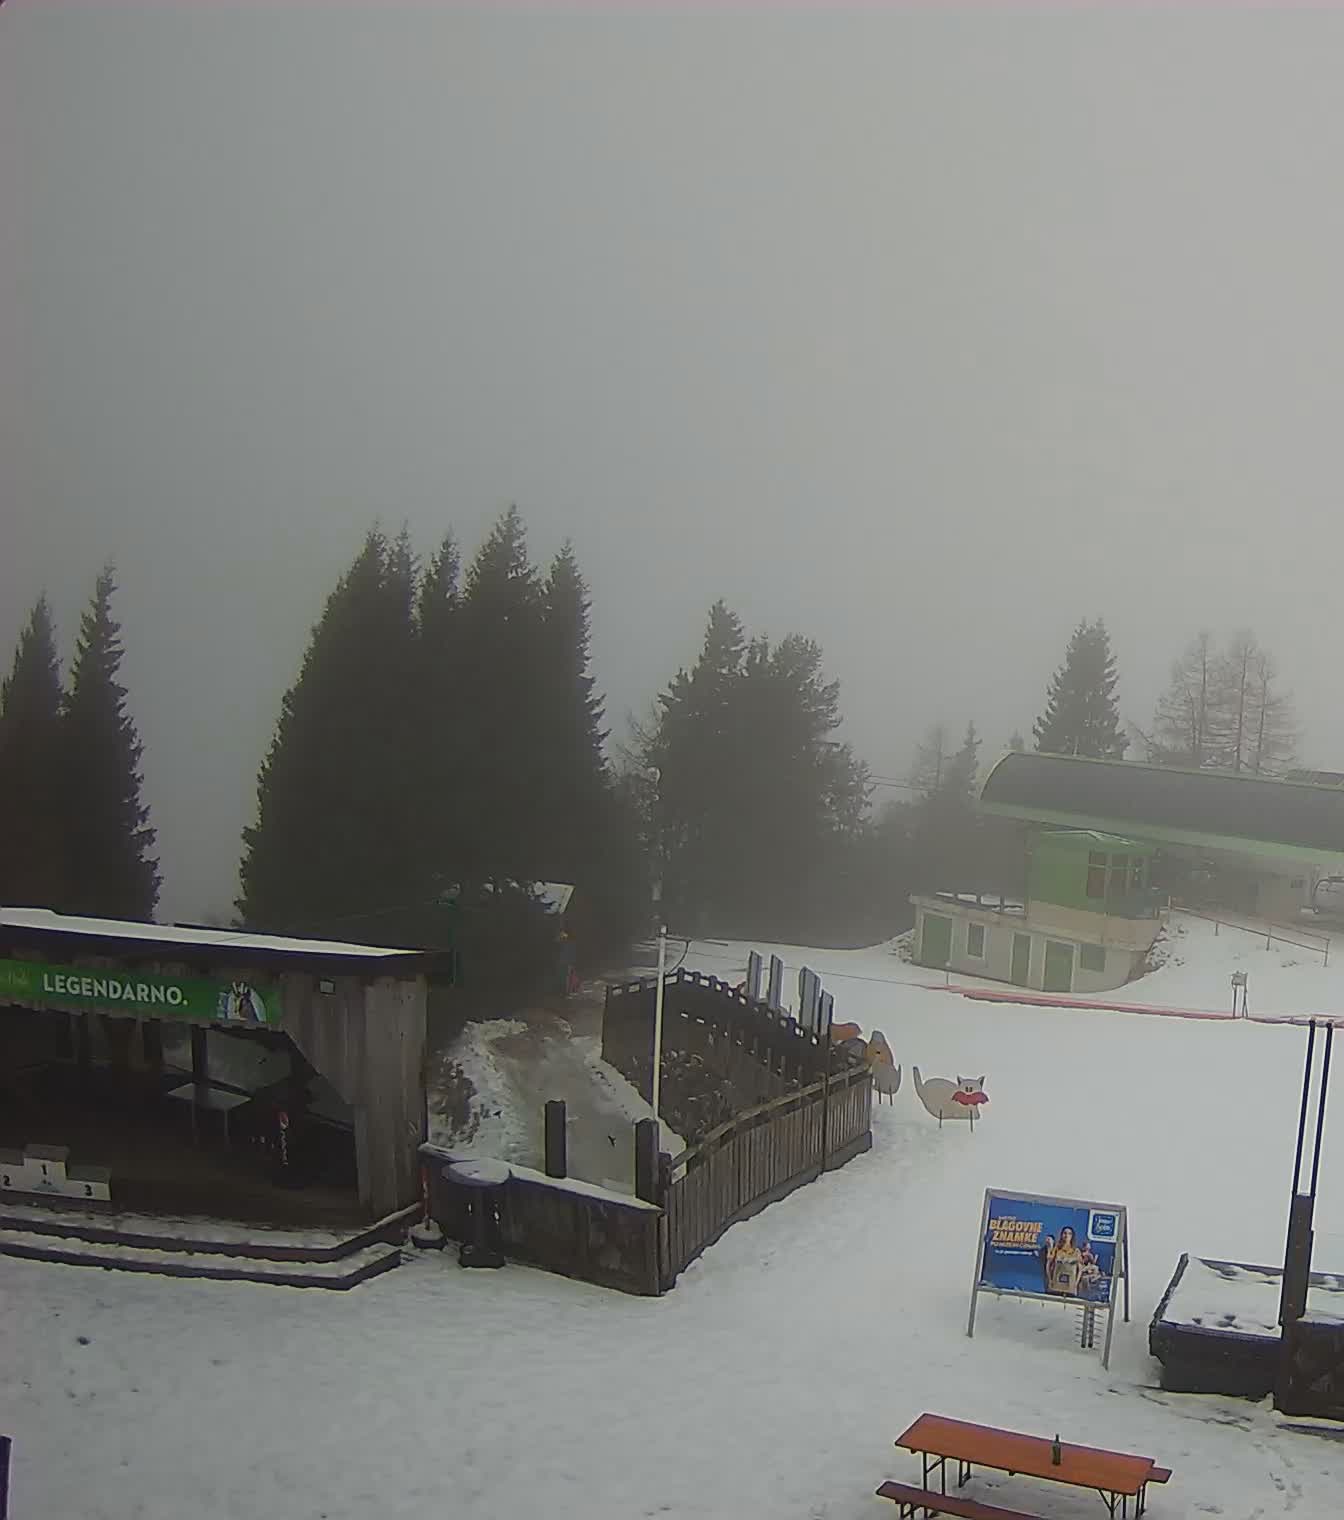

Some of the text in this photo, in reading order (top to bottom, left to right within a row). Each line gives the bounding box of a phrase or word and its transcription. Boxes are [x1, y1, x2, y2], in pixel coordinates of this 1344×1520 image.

[43, 973, 189, 1006] LEGENDARNO.
[41, 1163, 48, 1176] 1
[3, 1174, 11, 1187] 2
[84, 1183, 93, 1197] 3
[990, 1219, 1044, 1233] BLAGOVNE
[992, 1230, 1038, 1243] ZNAMKE
